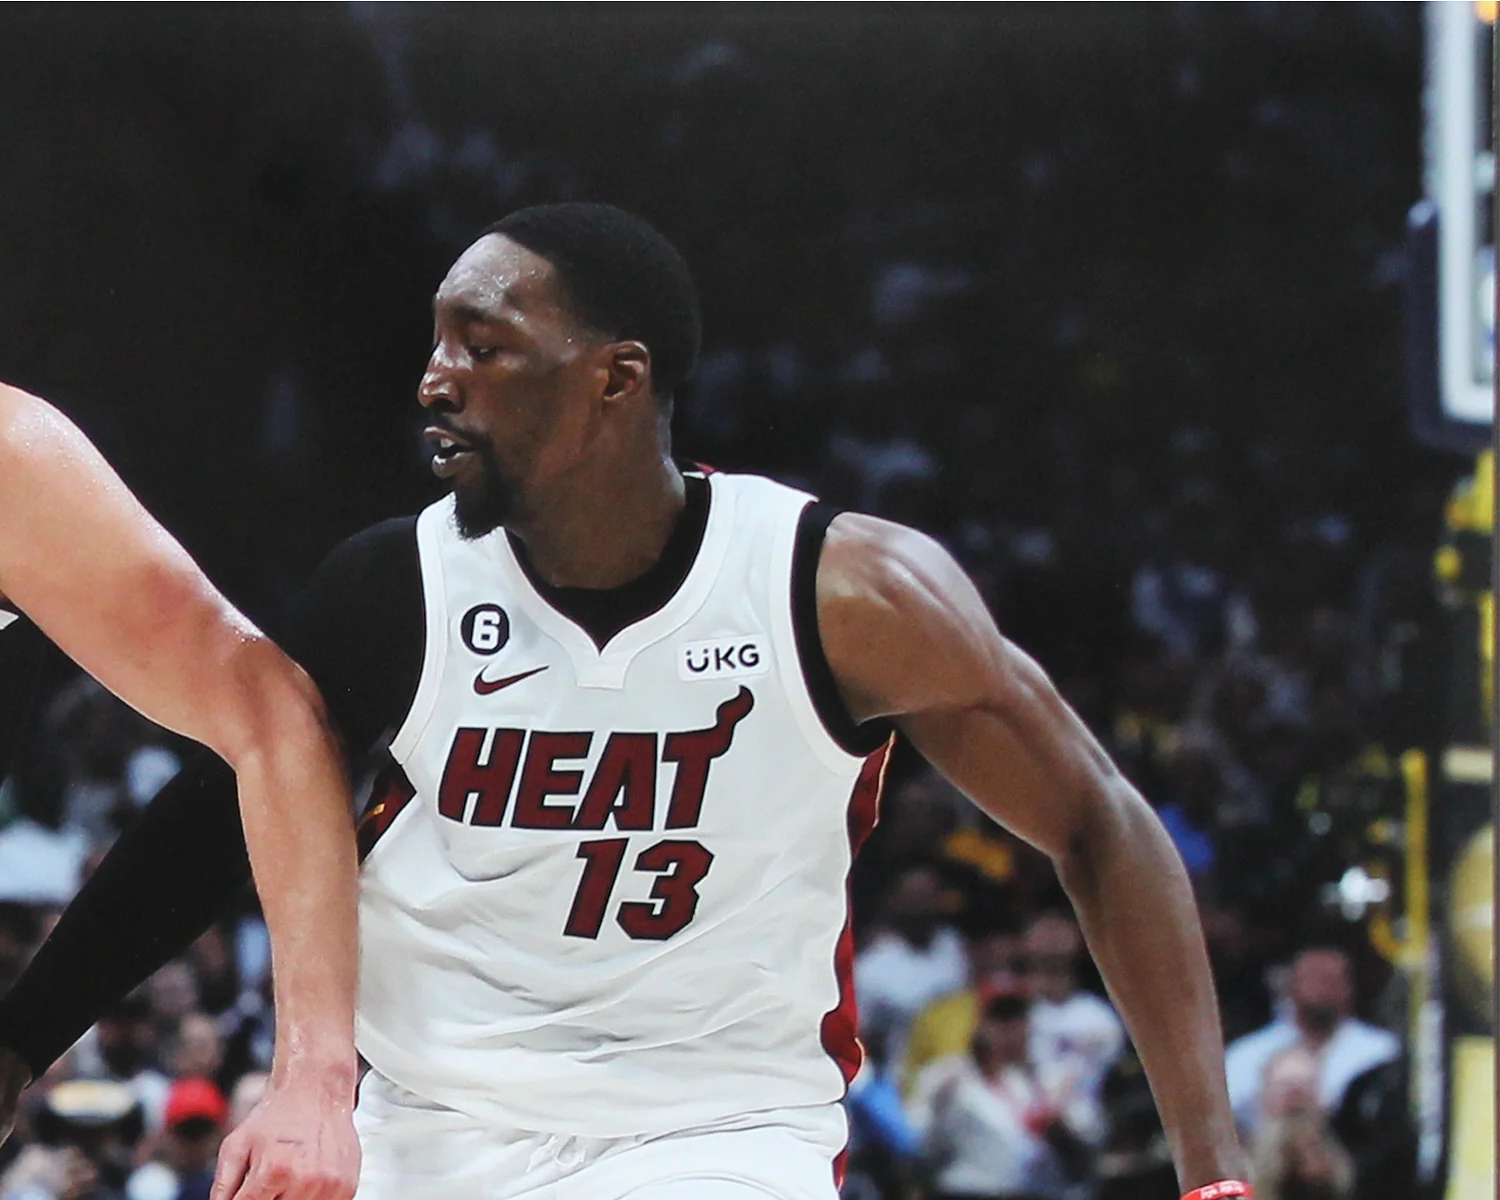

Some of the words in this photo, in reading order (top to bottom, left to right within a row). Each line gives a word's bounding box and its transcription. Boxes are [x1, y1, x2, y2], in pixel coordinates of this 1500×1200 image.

[471, 611, 500, 650] 6
[438, 685, 754, 831] HEAT
[563, 838, 715, 940] 13
